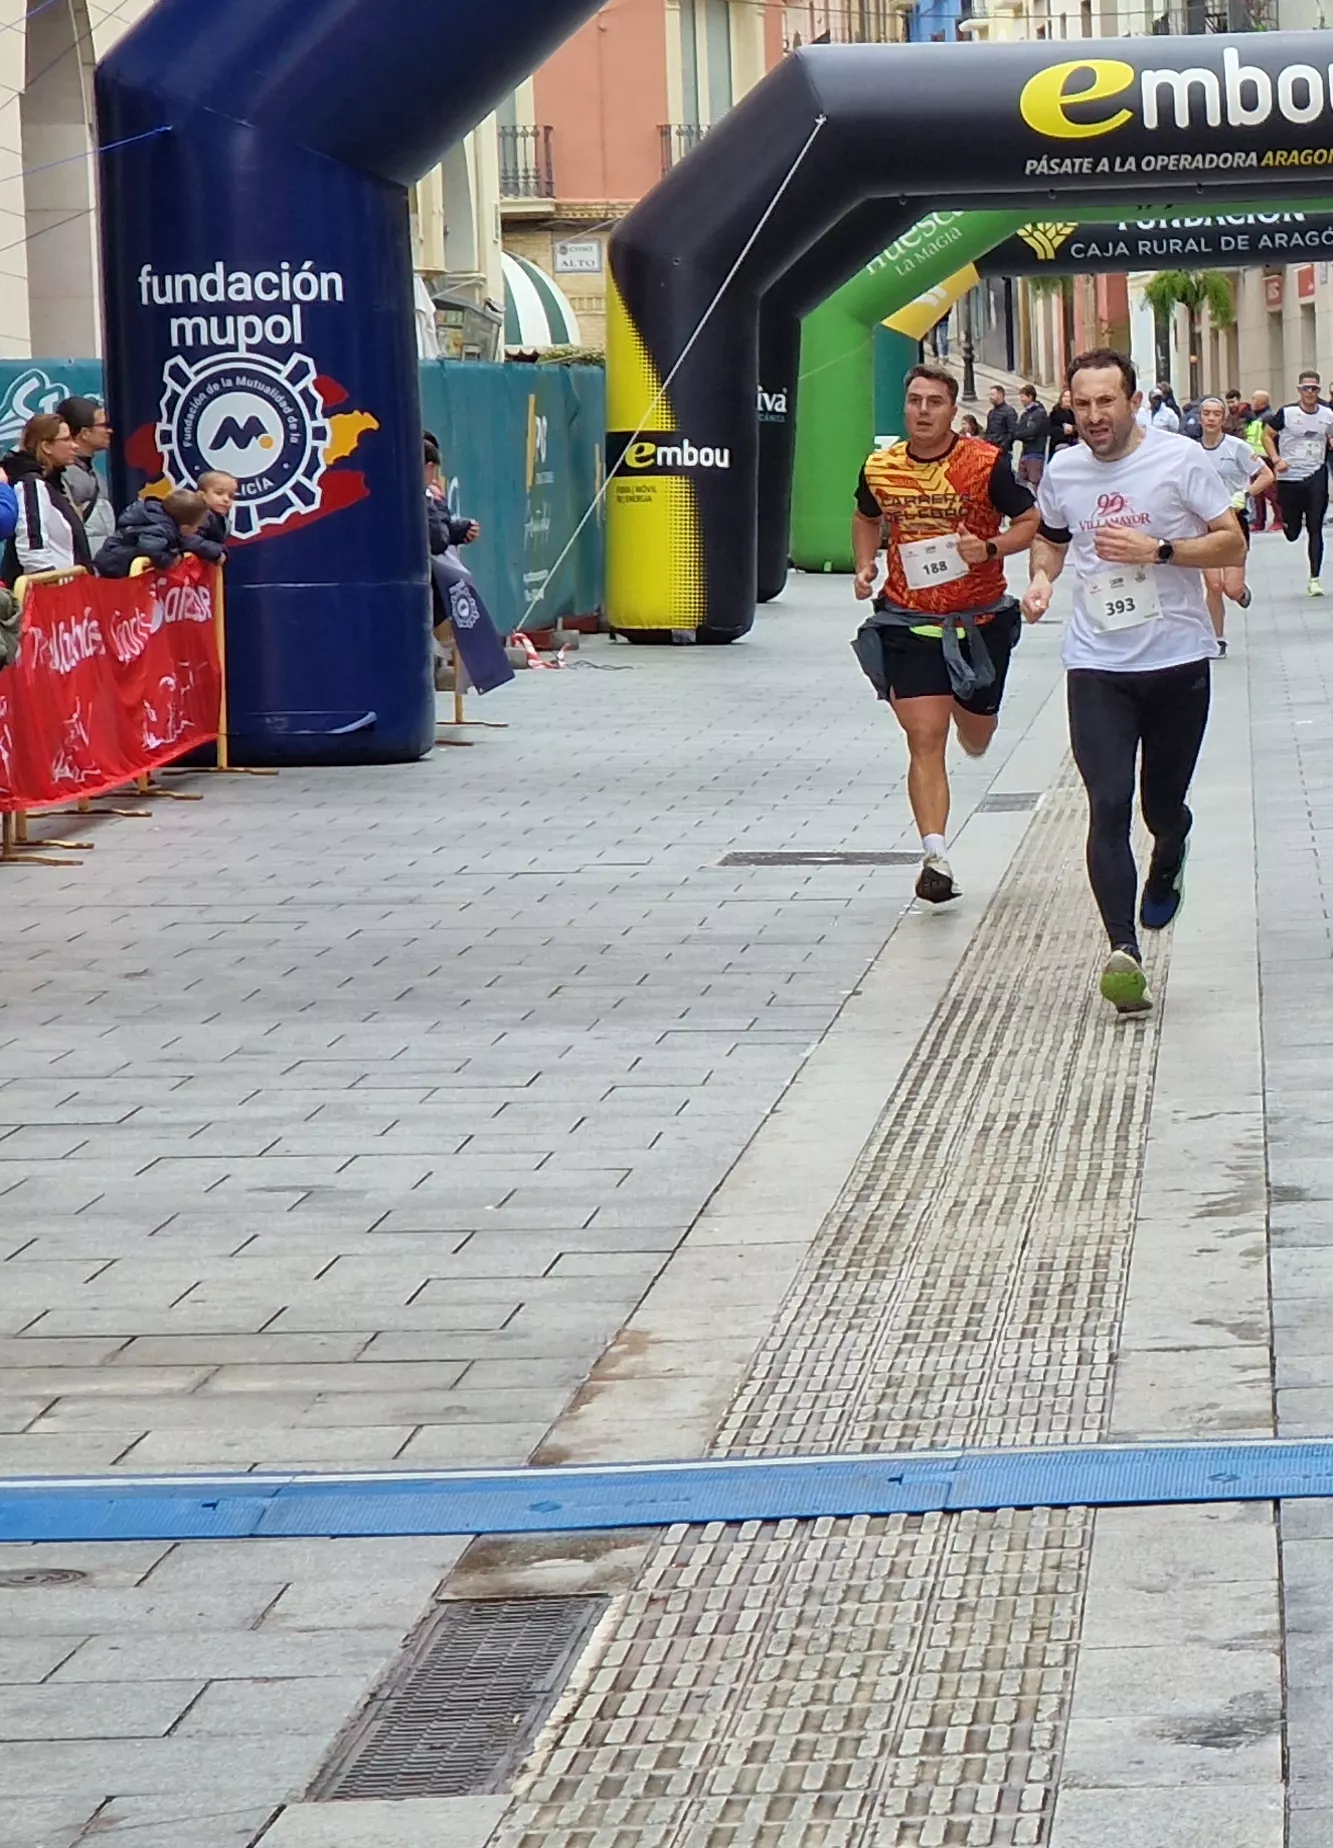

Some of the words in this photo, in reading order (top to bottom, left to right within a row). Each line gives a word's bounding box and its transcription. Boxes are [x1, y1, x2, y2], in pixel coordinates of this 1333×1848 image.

[1024, 154, 1093, 175] PÁSATE
[1096, 156, 1111, 173] A
[1114, 155, 1137, 173] LA
[1141, 150, 1259, 171] OPERADORA
[1070, 241, 1131, 259] CAJA
[1138, 236, 1213, 256] RURAL
[1220, 234, 1250, 252] DE
[561, 259, 596, 267] ALTO
[138, 260, 345, 306] fundación
[170, 304, 303, 352] mupol
[624, 438, 730, 469] embou
[923, 561, 948, 576] 188
[1105, 597, 1136, 616] 393
